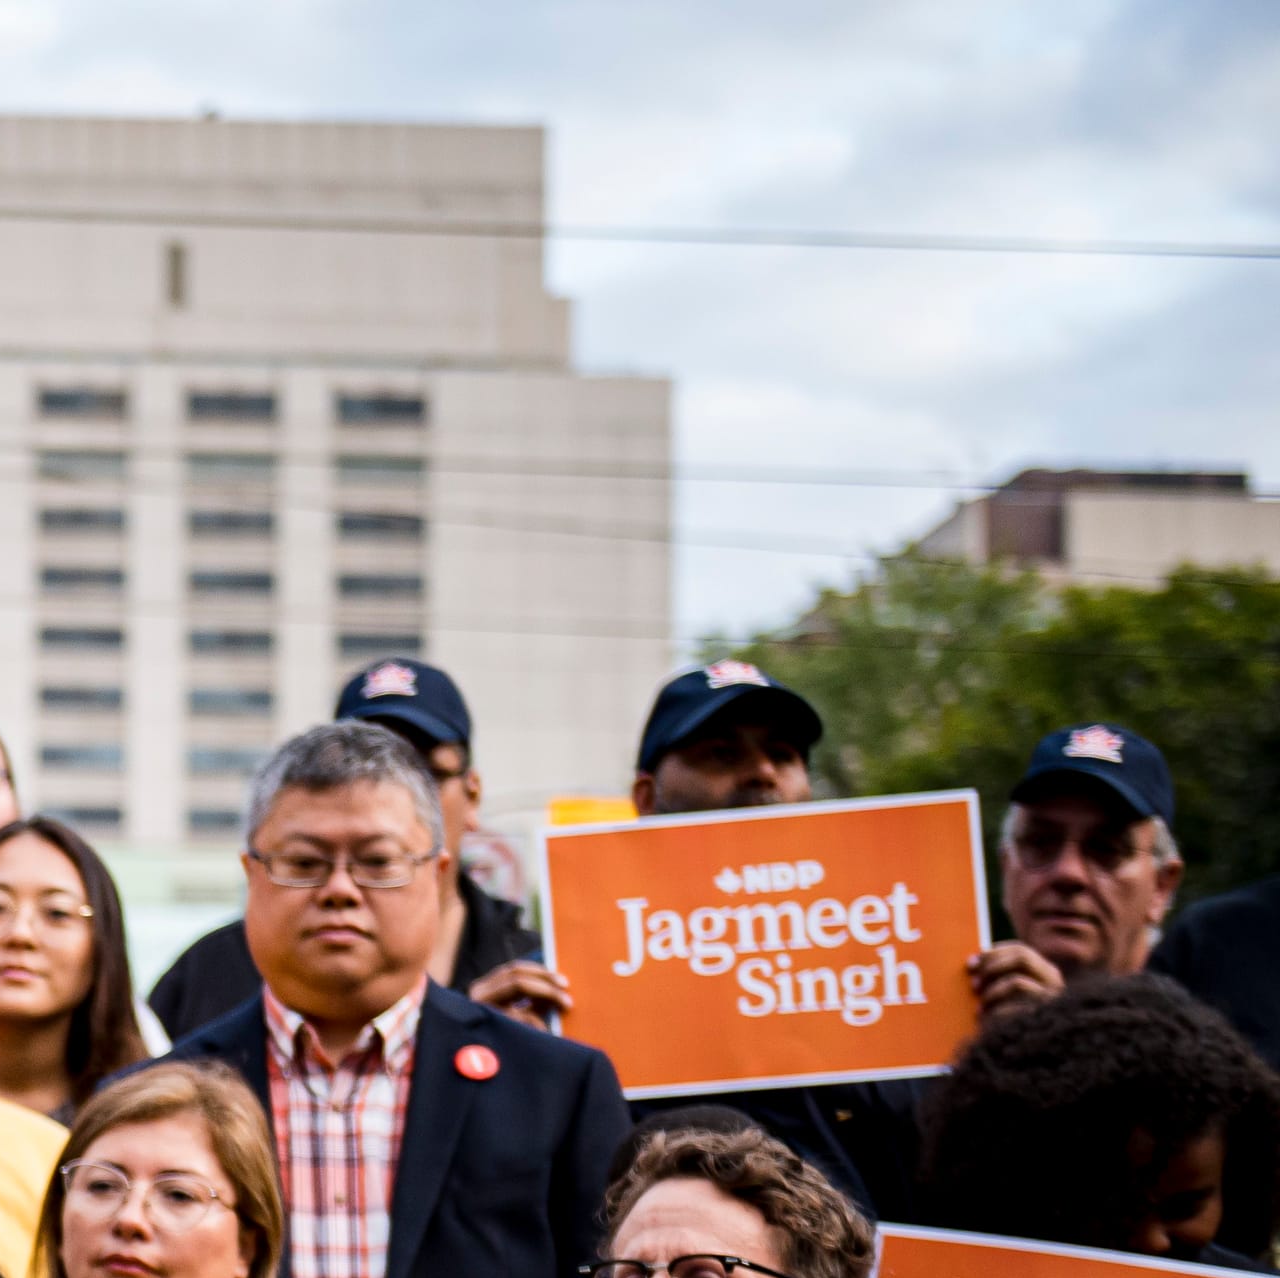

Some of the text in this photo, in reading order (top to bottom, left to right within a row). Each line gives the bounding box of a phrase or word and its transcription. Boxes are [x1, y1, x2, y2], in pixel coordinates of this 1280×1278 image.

[743, 860, 825, 894] NDP
[612, 882, 922, 977] Jagmeet
[737, 944, 928, 1027] Singh
